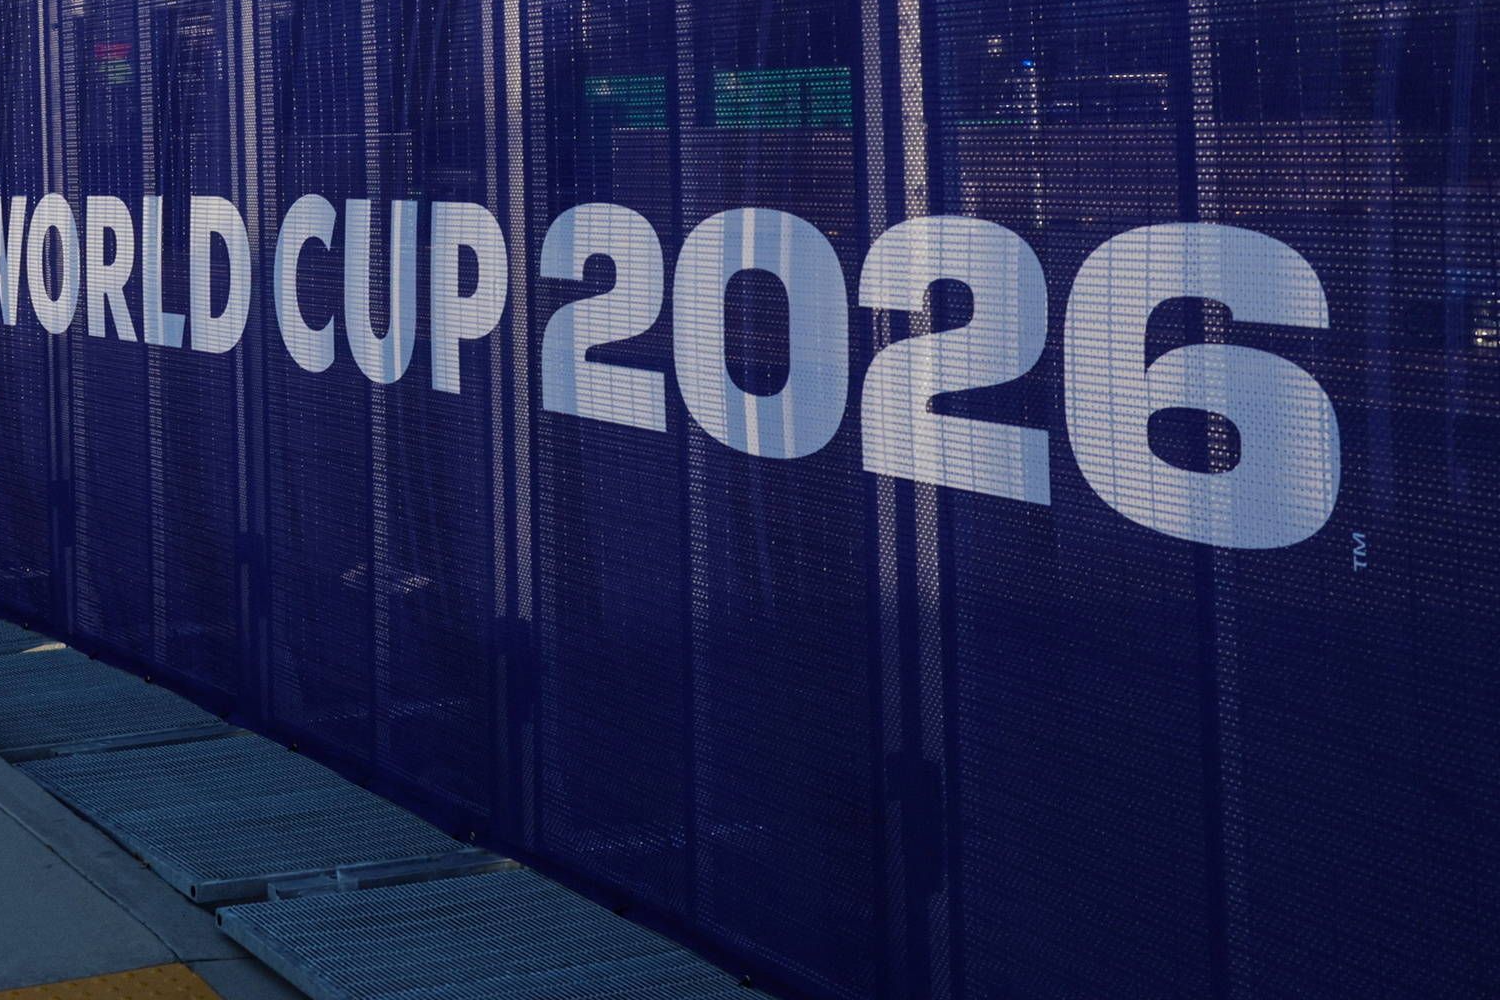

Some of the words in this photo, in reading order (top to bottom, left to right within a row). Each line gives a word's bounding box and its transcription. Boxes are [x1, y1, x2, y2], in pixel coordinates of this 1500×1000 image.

[273, 193, 508, 396] CUP
[540, 202, 1342, 550] 2026
[1352, 532, 1368, 572] TM
